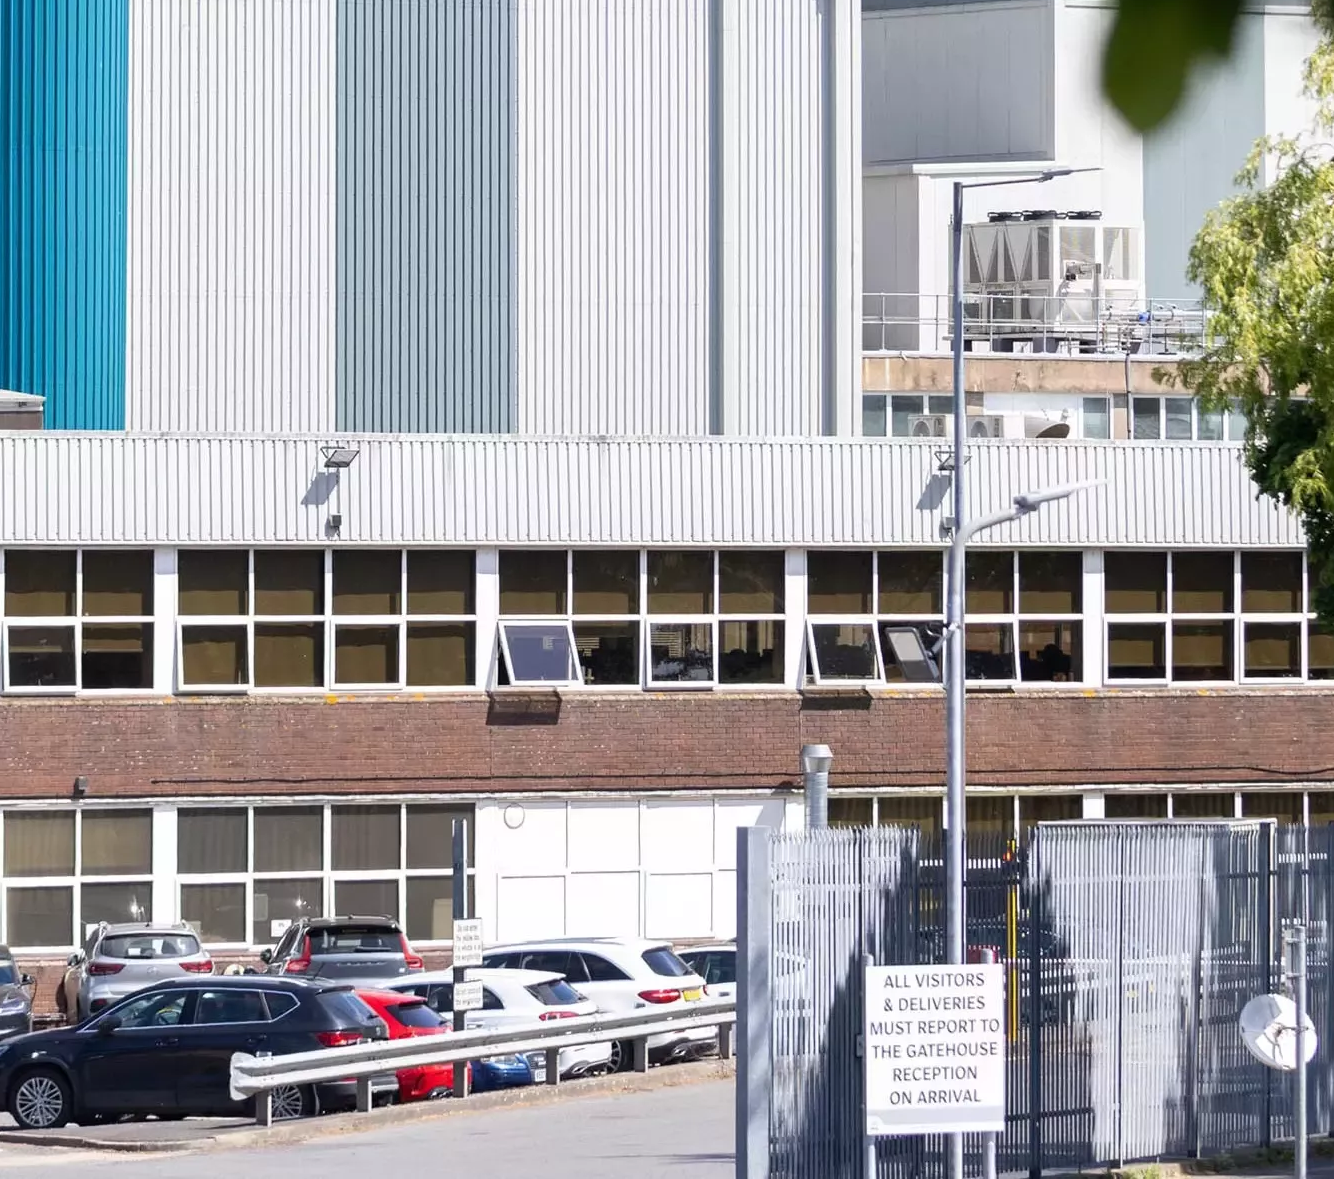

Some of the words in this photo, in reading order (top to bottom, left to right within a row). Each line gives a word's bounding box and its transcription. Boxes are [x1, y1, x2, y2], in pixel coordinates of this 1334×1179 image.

[884, 974, 911, 988] ALL
[915, 973, 985, 988] VISITORS
[884, 998, 893, 1012] &
[898, 996, 986, 1011] DELIVERIES
[870, 1021, 913, 1035] MUST
[918, 1019, 976, 1034] REPORT
[980, 1018, 1000, 1033] TO
[872, 1045, 901, 1059] THE
[906, 1042, 998, 1058] GATEHOUSE
[893, 1066, 977, 1081] RECEPTION
[889, 1090, 912, 1105] ON
[917, 1088, 982, 1104] ARRIVAL
